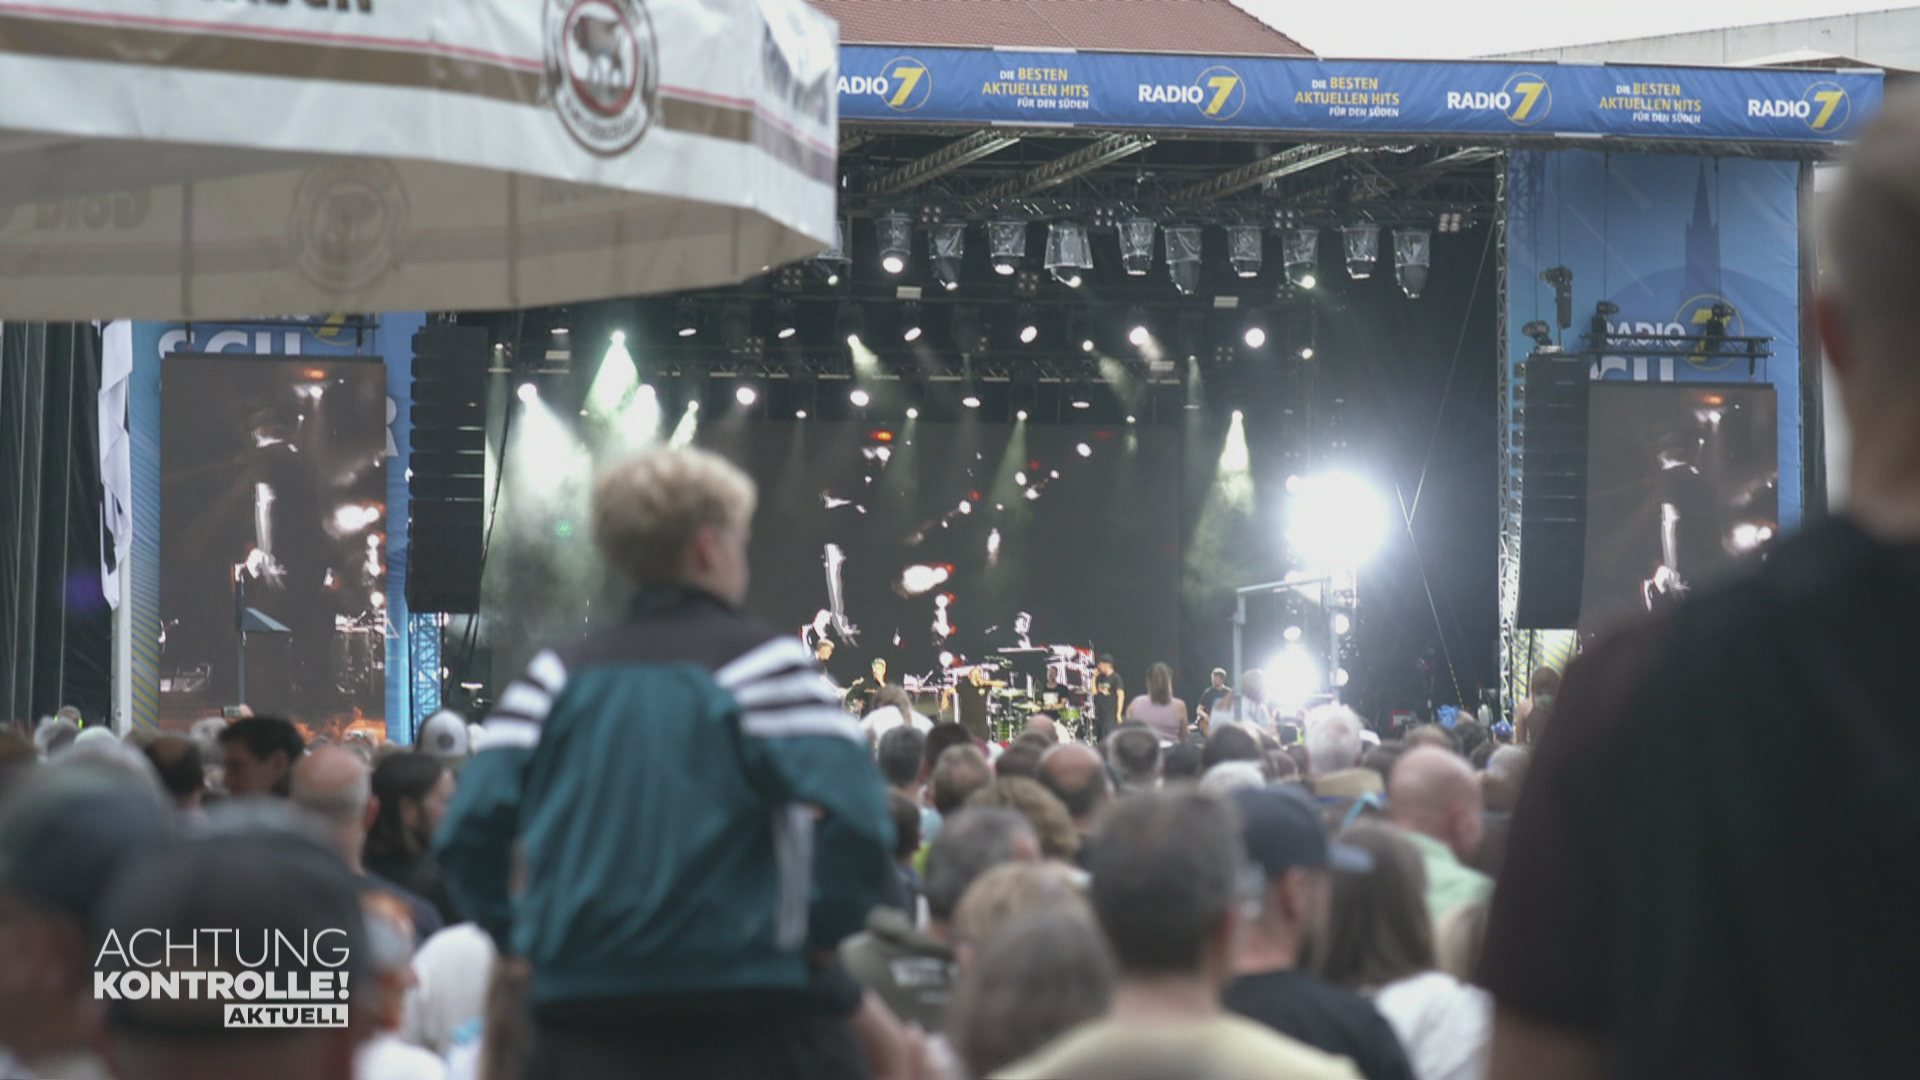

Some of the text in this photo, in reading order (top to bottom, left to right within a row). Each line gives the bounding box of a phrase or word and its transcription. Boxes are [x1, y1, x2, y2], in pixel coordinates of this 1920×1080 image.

[1000, 67, 1068, 81] DIE BESTEN
[836, 66, 925, 106] ADIO 7
[982, 82, 1090, 97] AKTUELLEN HITS
[1312, 77, 1378, 90] DIE BESTEN
[1616, 82, 1681, 96] DIE BESTEN
[1138, 76, 1239, 115] RADIO 7
[1295, 91, 1400, 105] AKTUELLEN HITS
[1447, 82, 1546, 120] RADIO 7
[1017, 96, 1090, 110] FÜR DEN SÜDEN
[1600, 97, 1702, 112] AKTUELLEN HITS
[1747, 91, 1844, 128] RADIO 7
[1329, 105, 1399, 117] FÜR DEN SÜDEN
[1633, 111, 1701, 124] FÜR DEN SÜDEN
